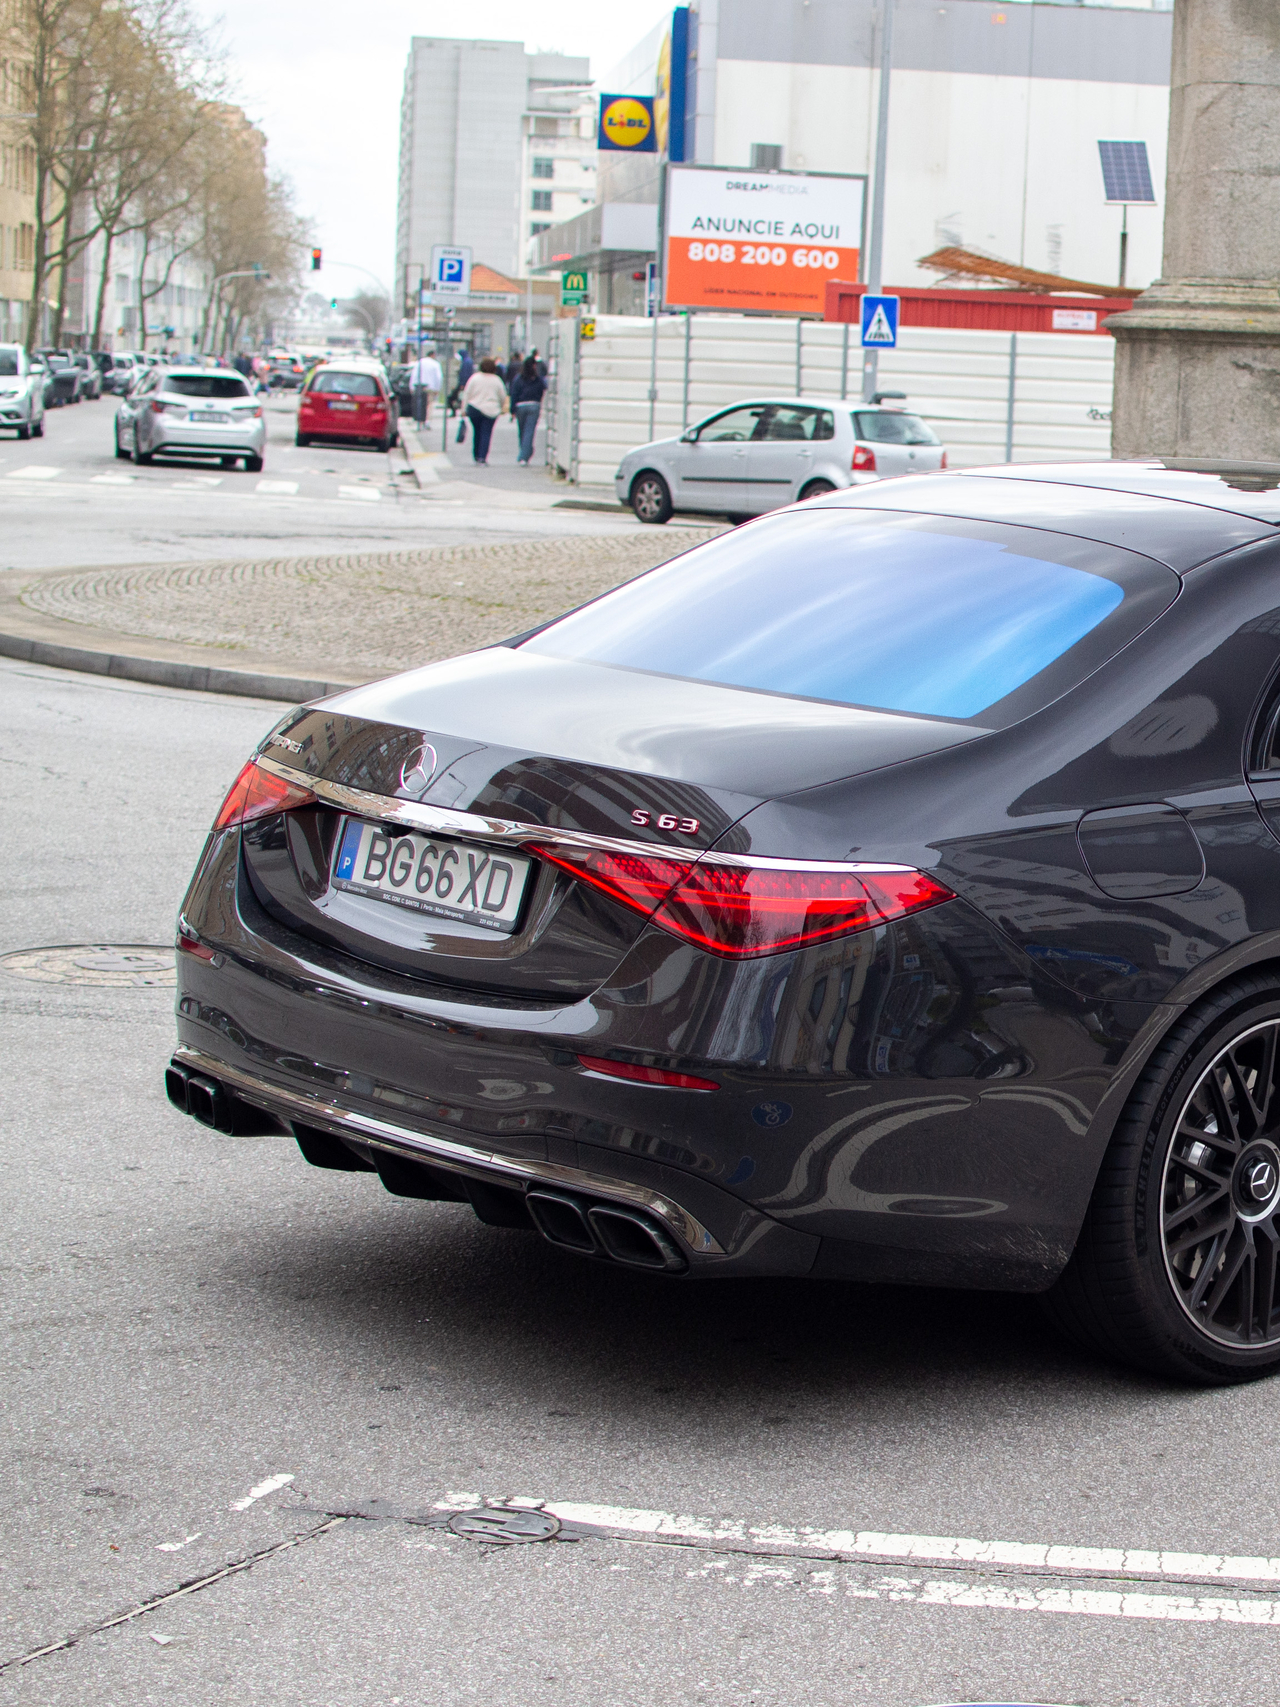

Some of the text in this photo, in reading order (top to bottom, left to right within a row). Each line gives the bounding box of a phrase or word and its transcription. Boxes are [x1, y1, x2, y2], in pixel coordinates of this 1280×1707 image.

[691, 216, 840, 239] ANUNCIE AQUI
[688, 242, 839, 270] 808 200 600
[442, 260, 460, 282] P
[727, 288, 764, 297] NACIONAL
[631, 809, 700, 836] S 63
[343, 857, 351, 870] P
[1155, 1094, 1168, 1124] PILOT
[1136, 1132, 1156, 1229] MICHELIN
